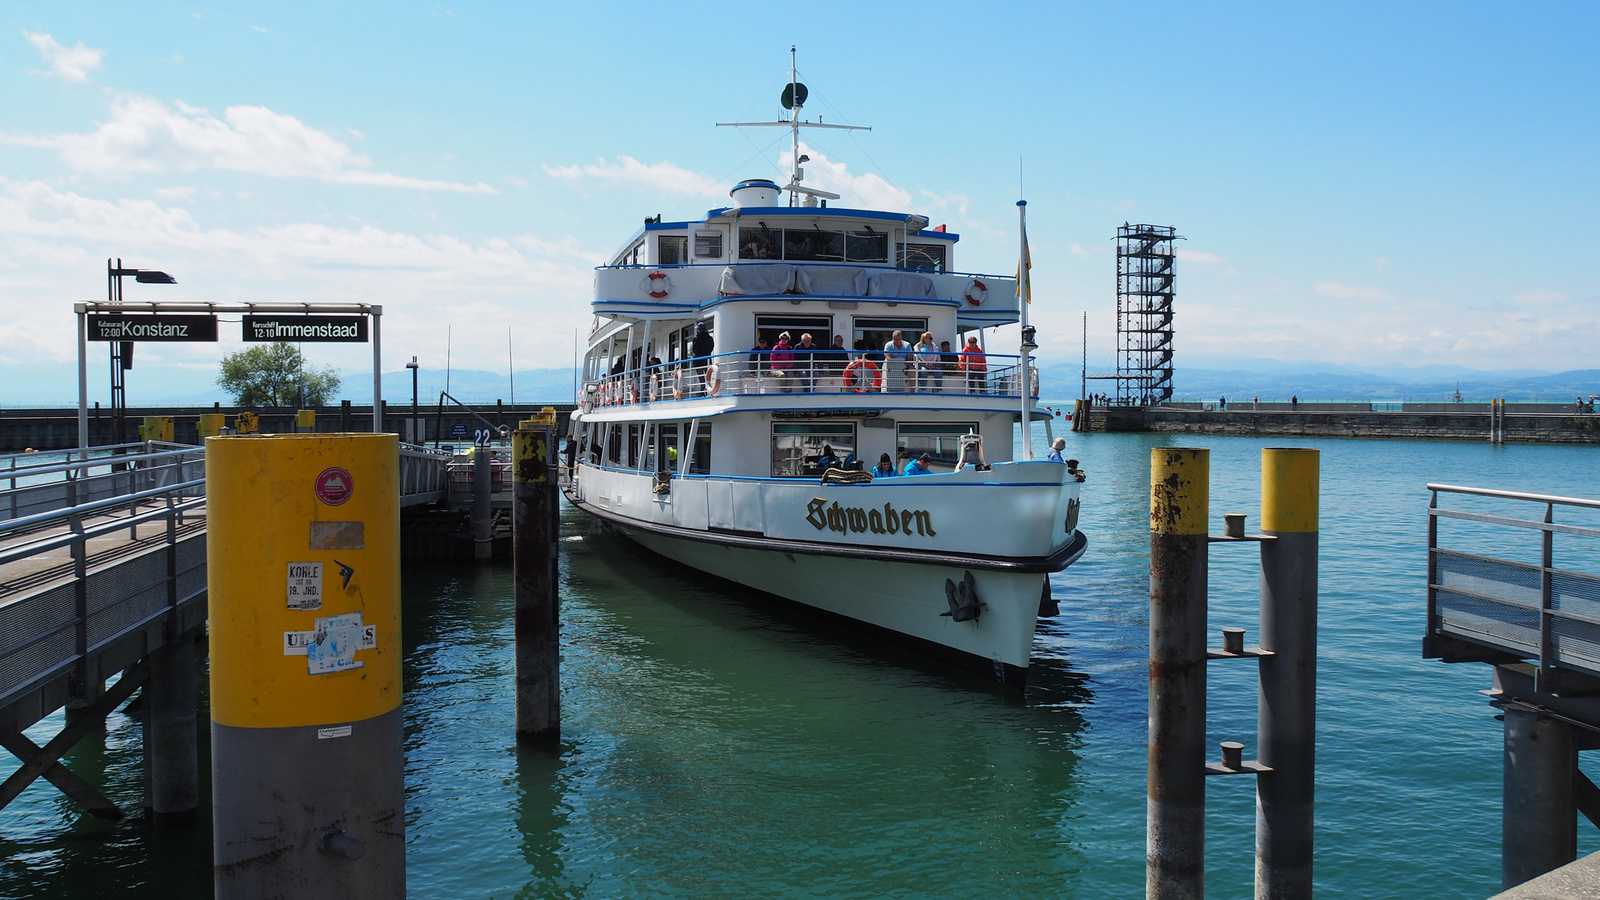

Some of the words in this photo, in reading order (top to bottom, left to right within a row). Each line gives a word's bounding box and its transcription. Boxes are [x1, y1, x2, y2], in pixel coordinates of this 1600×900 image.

[100, 328, 121, 337] 12:00
[122, 321, 189, 337] Konstanz
[254, 329, 275, 338] 12:10
[275, 321, 358, 337] Immenstaad
[475, 429, 490, 446] 22
[805, 496, 937, 537] Schwaben
[289, 566, 319, 578] KOHLE
[289, 586, 300, 596] 19.
[302, 586, 319, 596] JHD.
